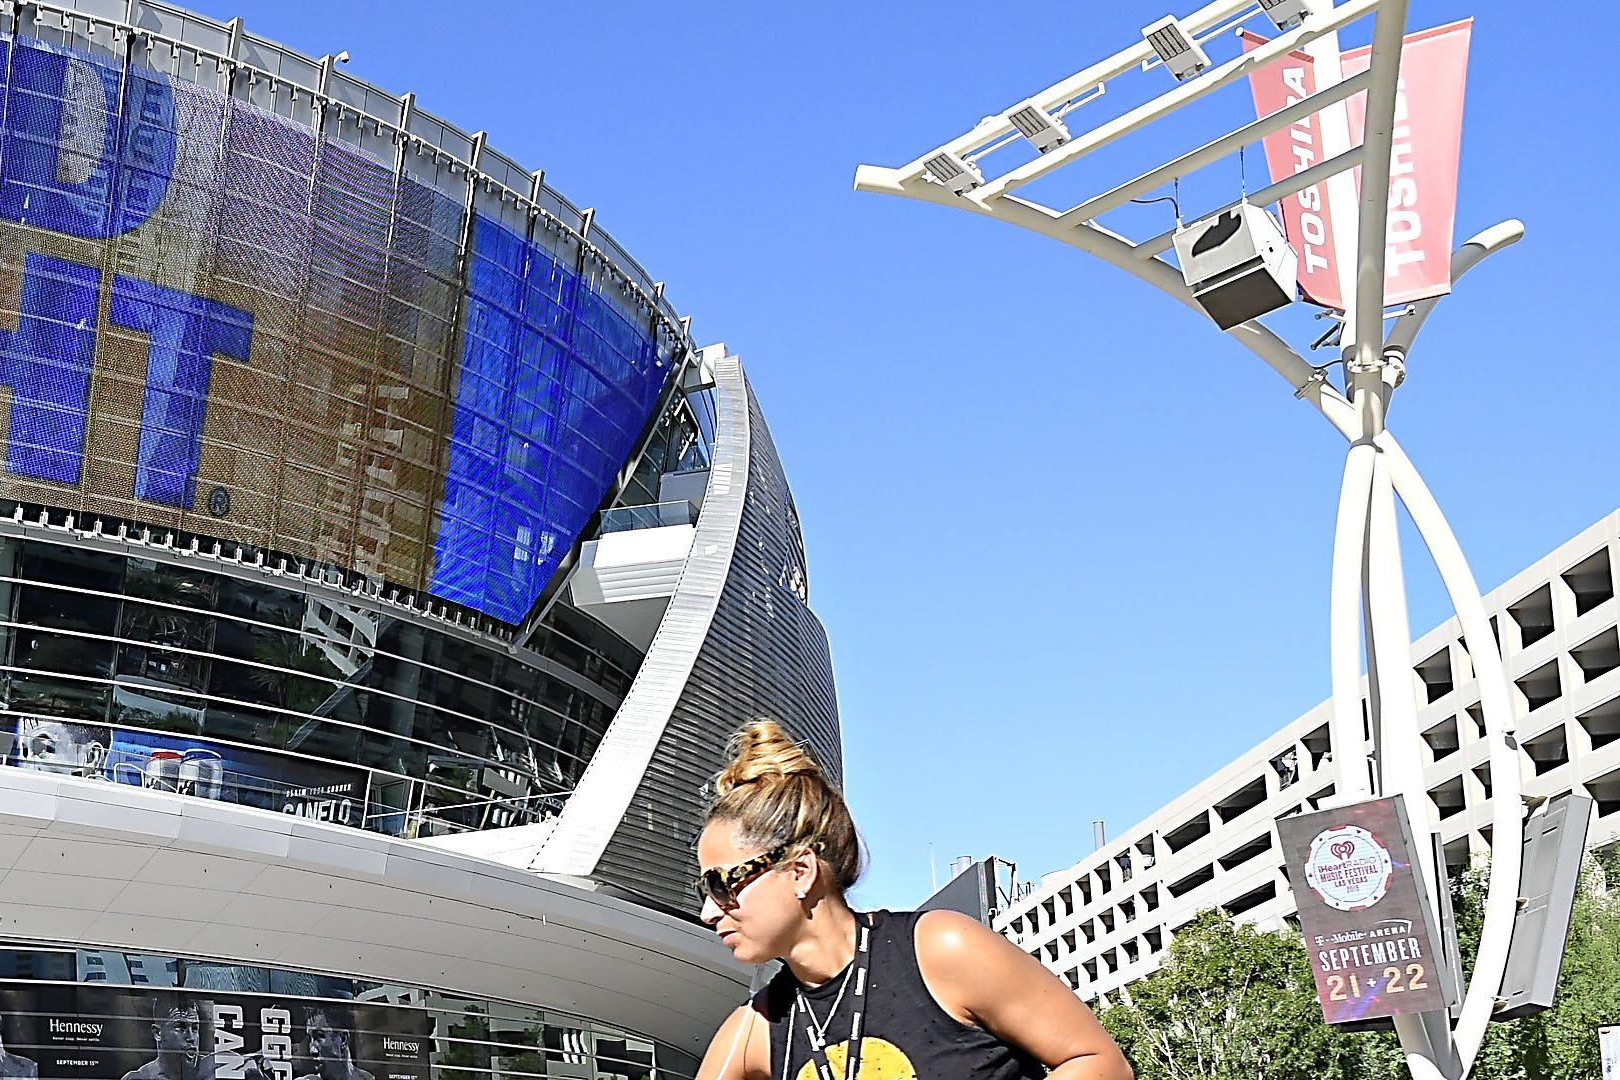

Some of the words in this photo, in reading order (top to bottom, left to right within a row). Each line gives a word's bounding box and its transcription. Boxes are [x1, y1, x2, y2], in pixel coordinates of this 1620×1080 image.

[1320, 871, 1343, 883] MUSIC
[1345, 864, 1379, 878] FESTIVAL
[1334, 879, 1346, 888] LAS
[1347, 875, 1368, 886] VEGAS
[1369, 925, 1407, 938] ARENA
[1318, 937, 1422, 972] SEPTEMBER
[1326, 972, 1361, 1001] 21
[1383, 963, 1429, 994] 22
[49, 1018, 103, 1037] Hennessy
[383, 1037, 420, 1054] Hennessy
